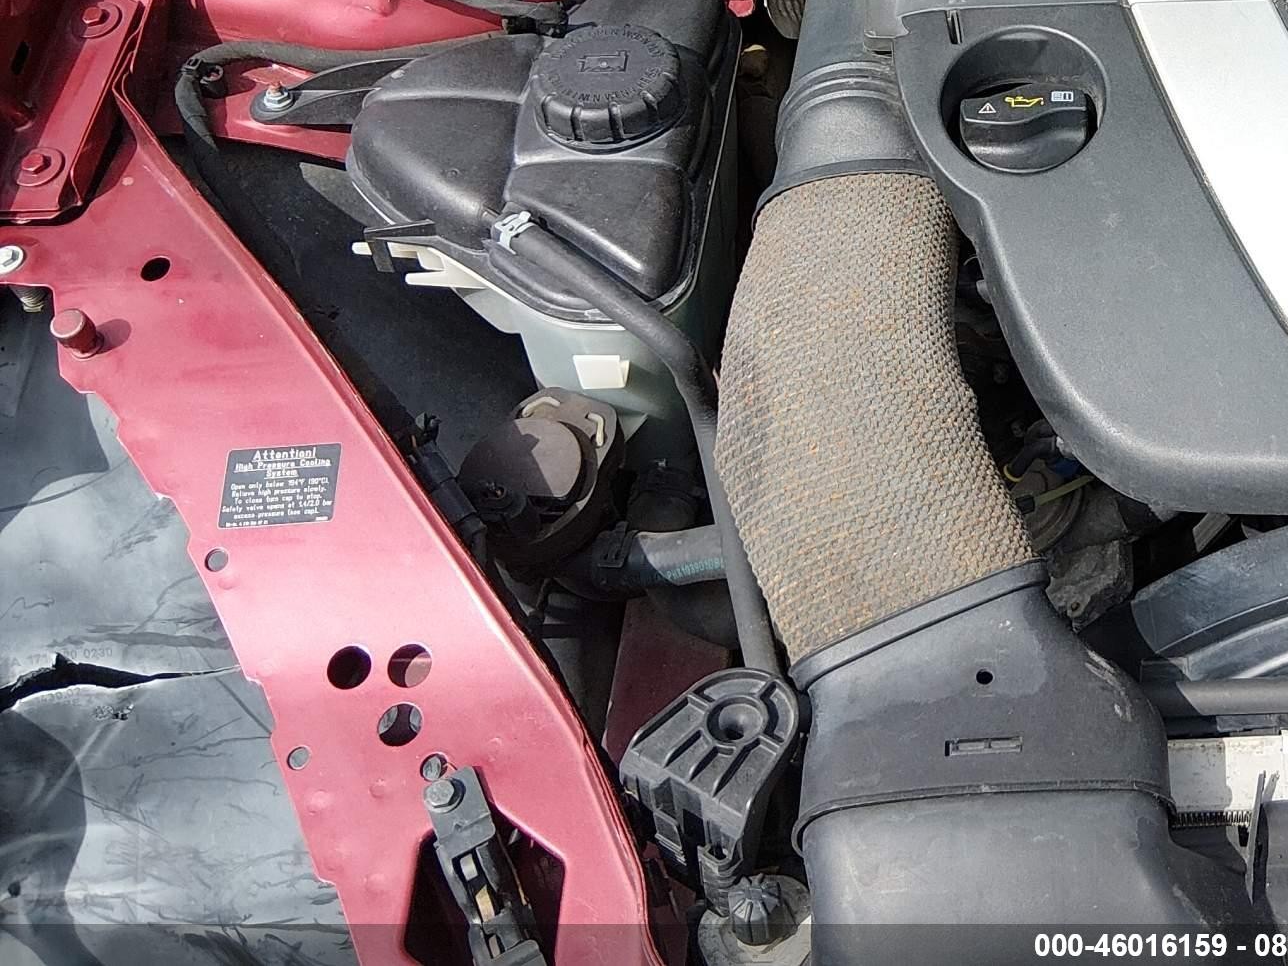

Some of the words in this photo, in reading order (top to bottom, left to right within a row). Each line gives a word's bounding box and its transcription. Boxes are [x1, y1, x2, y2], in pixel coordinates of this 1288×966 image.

[252, 447, 316, 460] Attention!
[236, 462, 253, 471] High
[258, 461, 295, 470] Pressure
[300, 458, 331, 467] Cooling
[266, 468, 298, 477] System
[231, 483, 245, 491] Open
[249, 482, 262, 490] only
[235, 497, 242, 505] To
[222, 505, 243, 513] Safety
